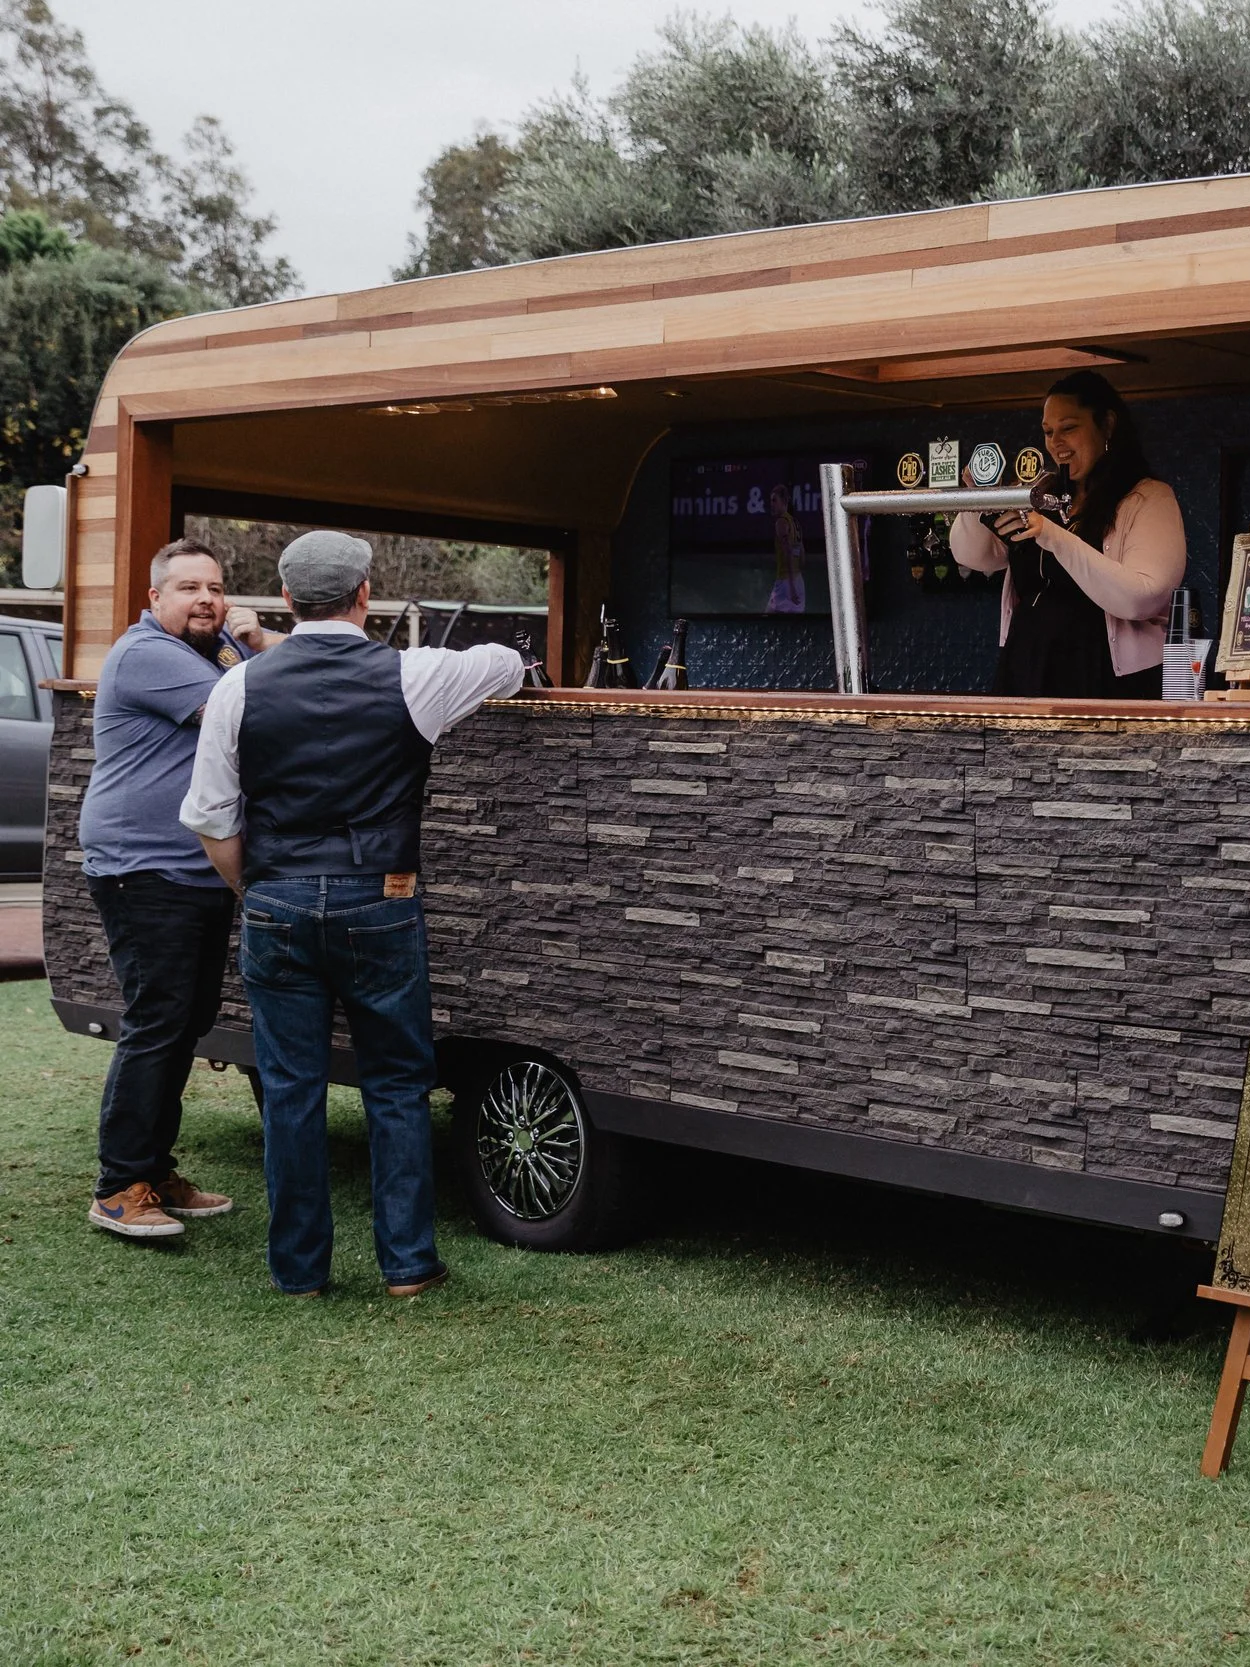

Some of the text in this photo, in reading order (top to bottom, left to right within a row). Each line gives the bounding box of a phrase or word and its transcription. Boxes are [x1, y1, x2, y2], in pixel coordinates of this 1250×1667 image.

[978, 450, 996, 467] FURPHY
[931, 465, 956, 476] LASHES
[747, 486, 766, 514] &
